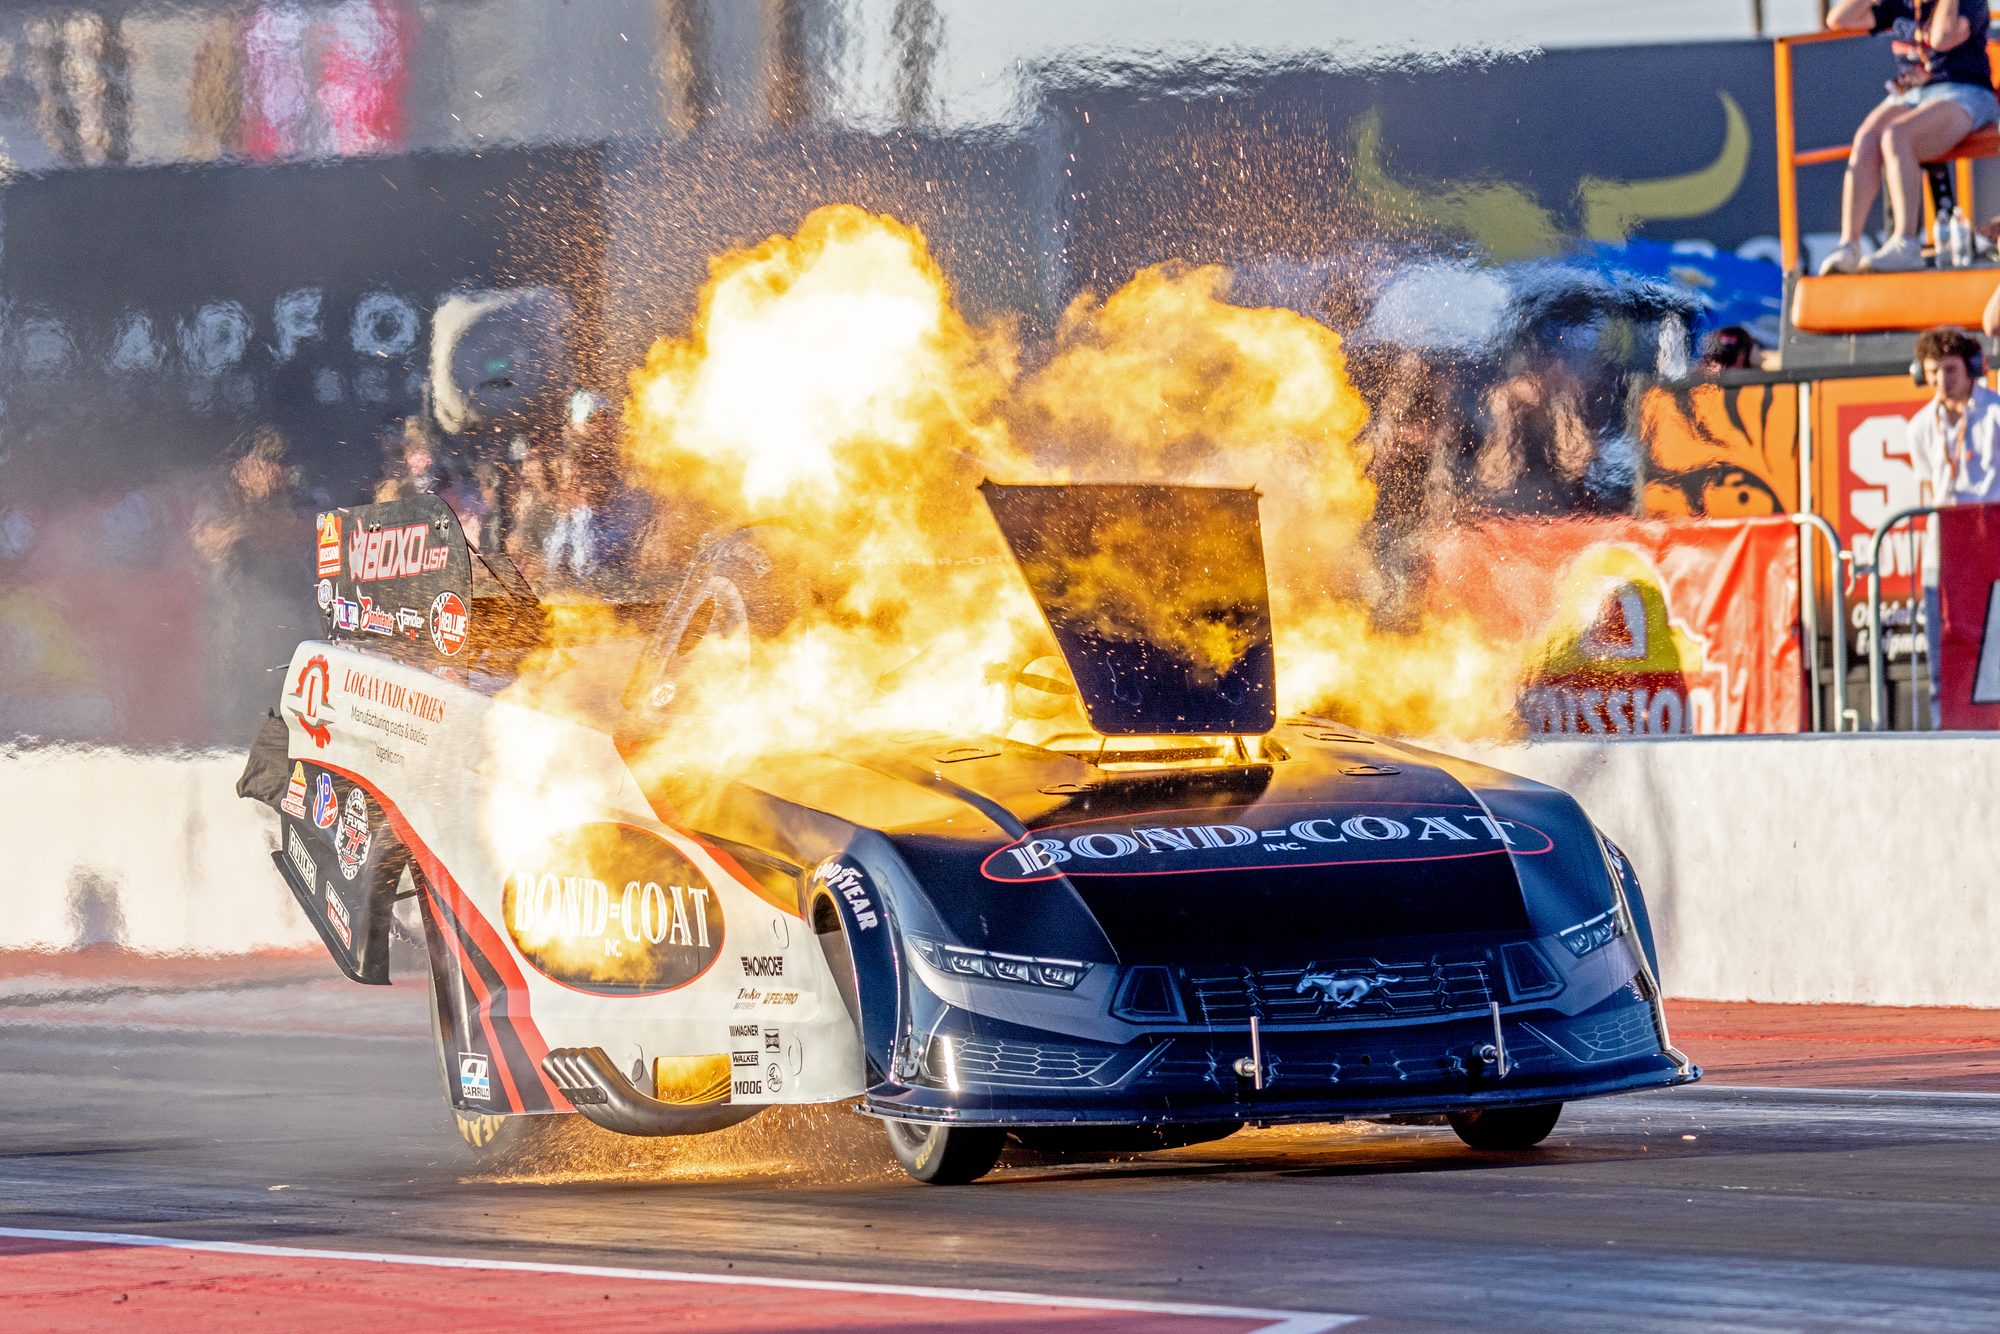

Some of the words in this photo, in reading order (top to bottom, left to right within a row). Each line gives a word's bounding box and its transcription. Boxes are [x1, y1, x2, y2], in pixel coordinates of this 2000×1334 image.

[361, 525, 427, 582] BOXO
[423, 546, 449, 571] USA
[343, 669, 379, 702] LOGAN
[381, 681, 446, 724] INDUSTRIES
[351, 704, 390, 736] Manufacturing
[1007, 815, 1516, 876] BOND-COAT
[1263, 842, 1307, 852] INC.
[604, 939, 623, 957] INC.
[746, 956, 780, 976] MONROE
[734, 1025, 759, 1037] WAGNER
[733, 1054, 759, 1064] WALKER
[733, 1081, 762, 1095] MOOG
